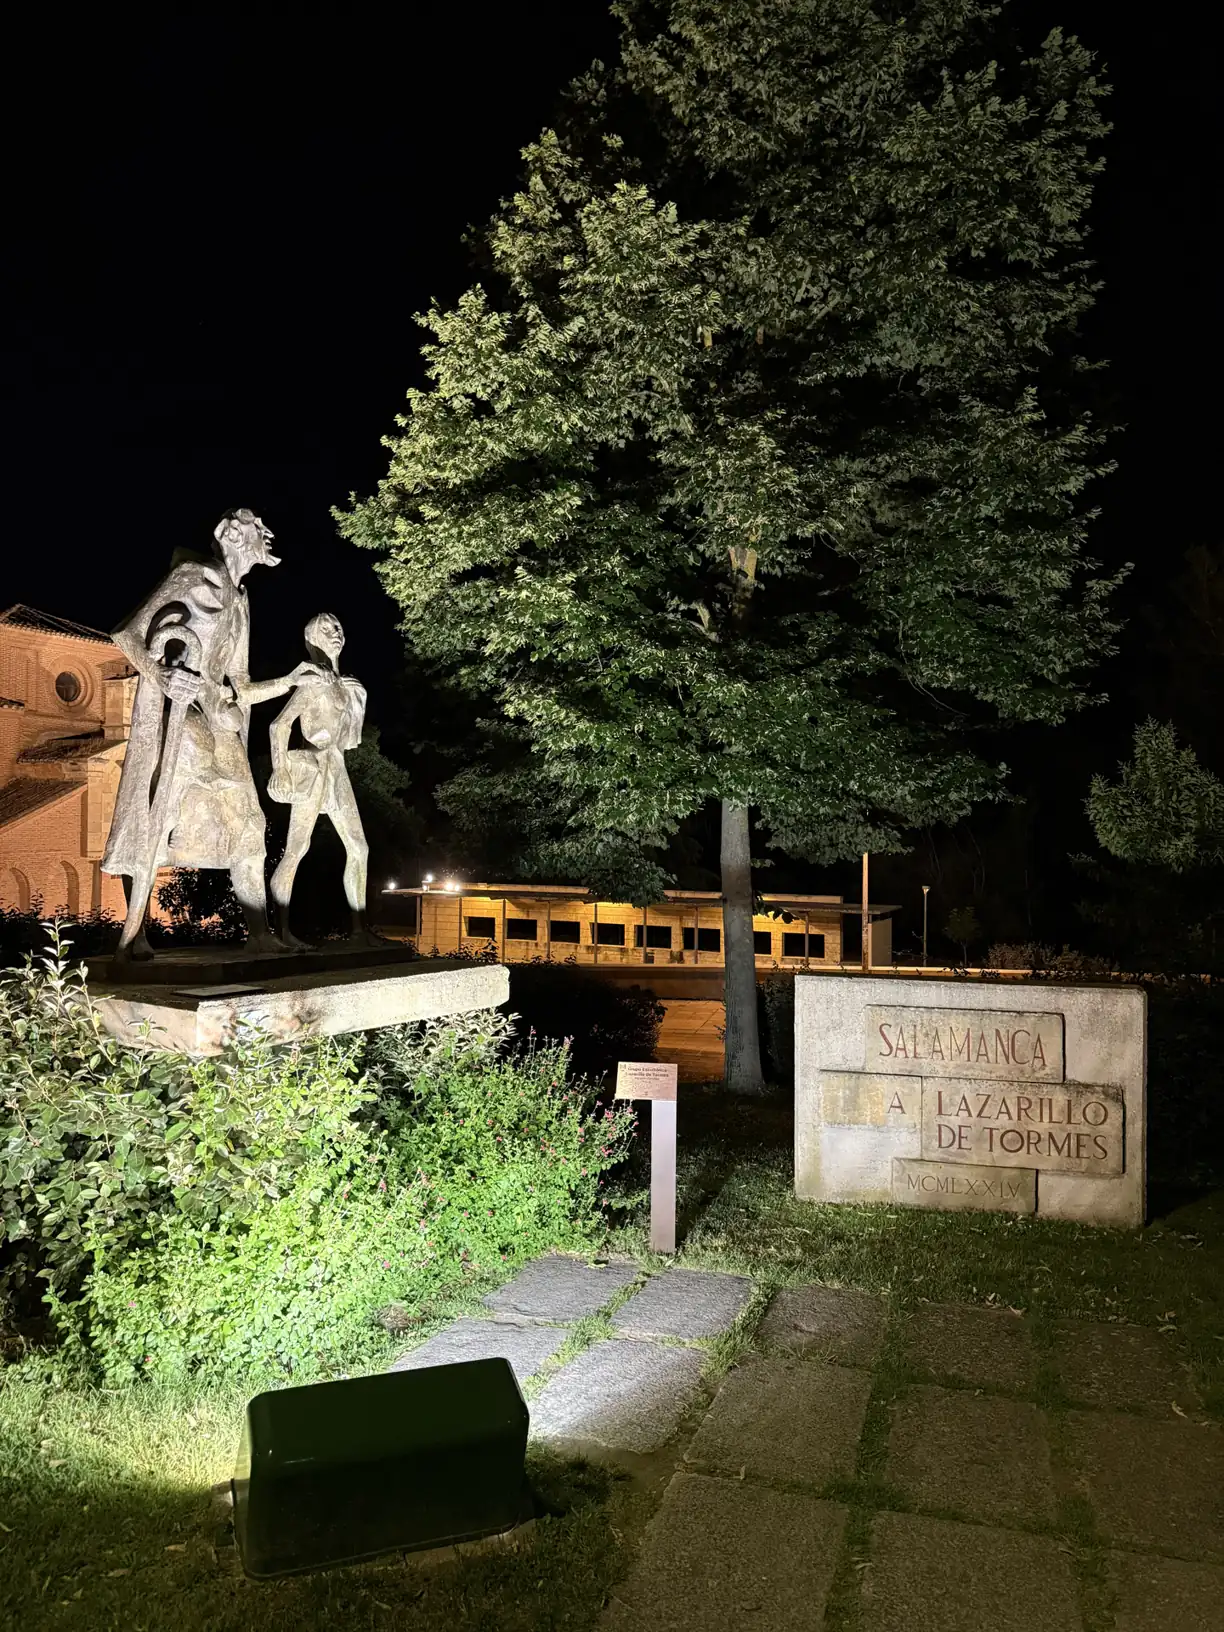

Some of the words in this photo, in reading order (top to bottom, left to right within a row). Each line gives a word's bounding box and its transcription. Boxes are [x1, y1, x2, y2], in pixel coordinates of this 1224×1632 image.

[878, 1023, 1047, 1067] SALAMANCA
[887, 1091, 906, 1115] A
[936, 1090, 1109, 1126] LAZARILLO
[936, 1123, 972, 1151] DE
[982, 1126, 1108, 1160] TORMES
[907, 1173, 1022, 1198] MCMLXXIV
